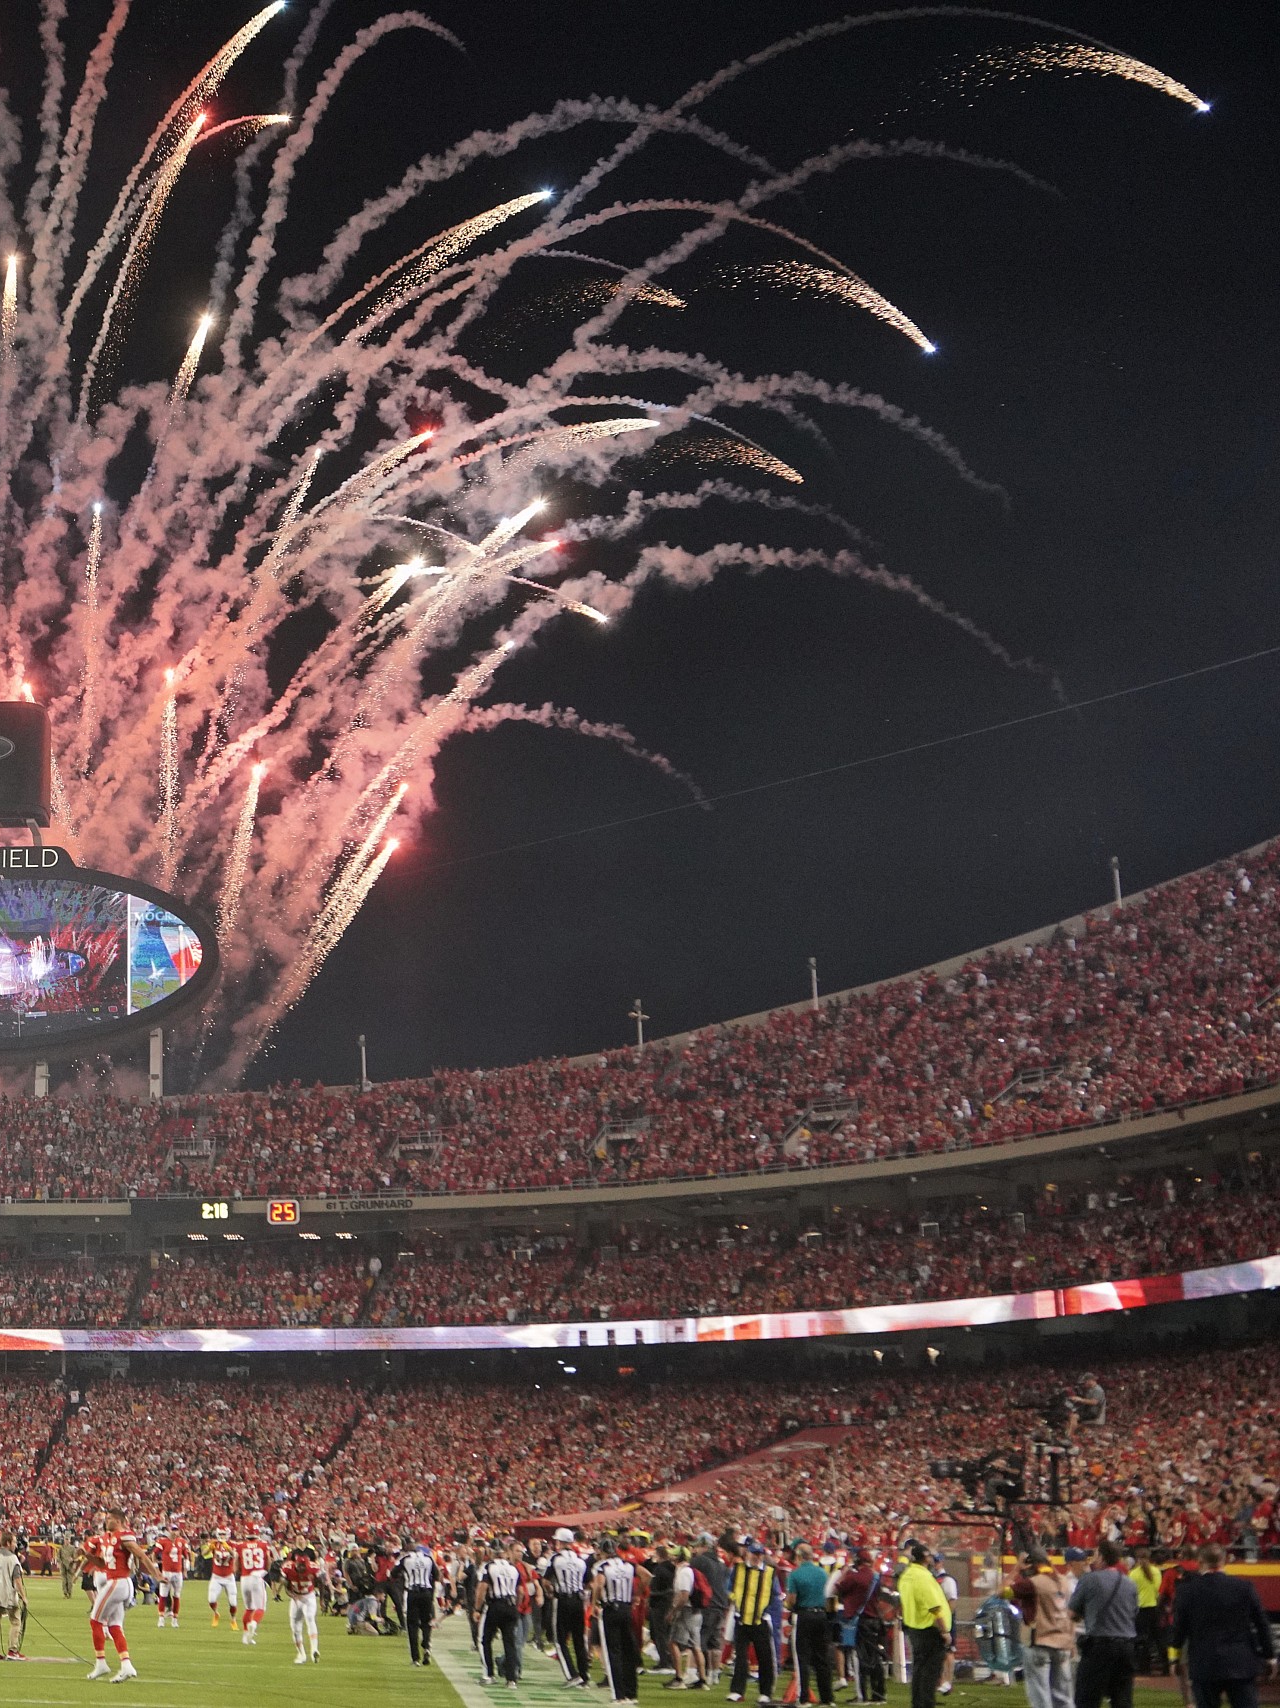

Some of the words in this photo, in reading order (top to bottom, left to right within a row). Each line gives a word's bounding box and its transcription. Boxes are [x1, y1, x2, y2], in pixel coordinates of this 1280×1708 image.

[272, 1202, 295, 1221] 25
[326, 1202, 337, 1210] 61
[339, 1201, 349, 1210] T.
[349, 1199, 414, 1210] GRUNHARD
[169, 1546, 180, 1563] 4
[241, 1547, 265, 1570] 83
